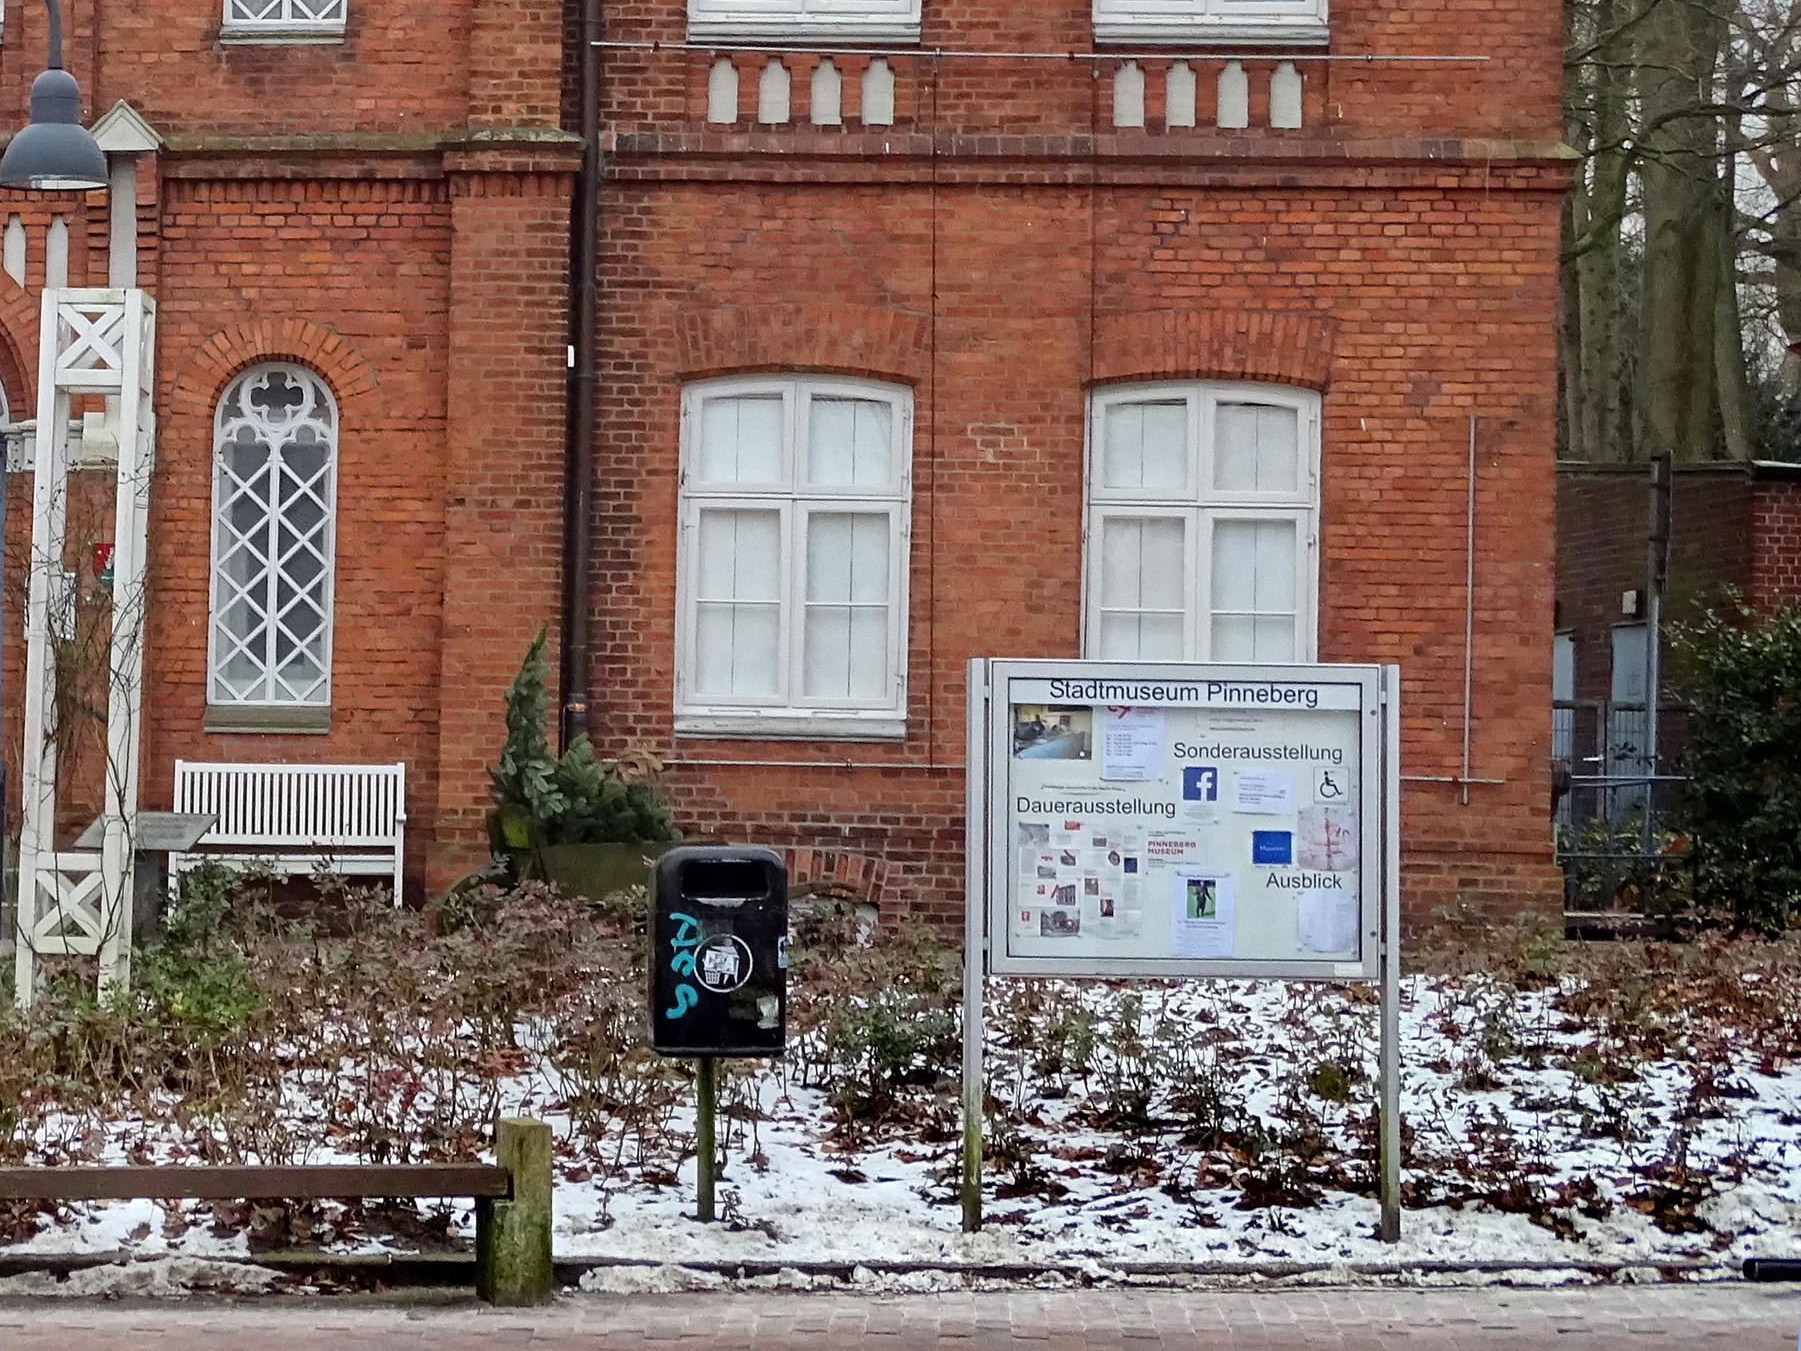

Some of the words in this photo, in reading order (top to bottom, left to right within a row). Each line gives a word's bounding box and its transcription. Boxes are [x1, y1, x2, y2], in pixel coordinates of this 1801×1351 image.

[1049, 679, 1199, 701] Stadtmuseum
[1207, 682, 1319, 708] Pinneberg
[1173, 742, 1343, 764] Sonderausstellung
[1016, 796, 1176, 818] Dauerausstellung
[1147, 840, 1197, 848] PINNEBERG
[1147, 848, 1184, 856] MUSEUM
[1265, 872, 1342, 890] Ausblick
